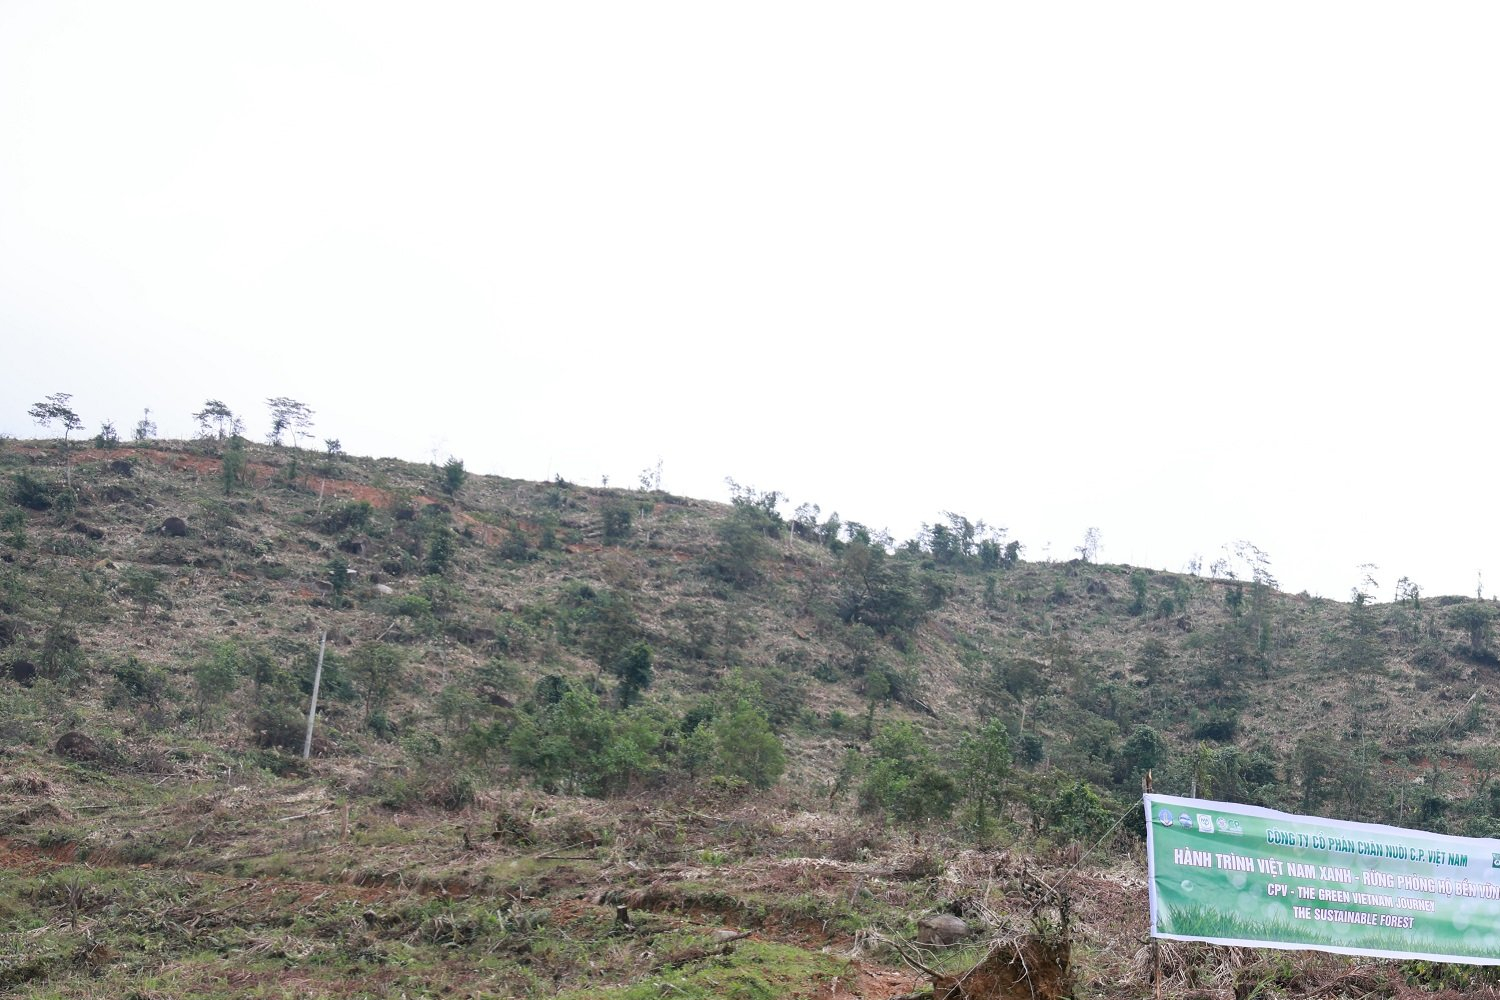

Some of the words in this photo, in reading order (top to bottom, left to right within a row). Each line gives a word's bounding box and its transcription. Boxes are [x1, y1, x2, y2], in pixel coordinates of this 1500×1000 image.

[1266, 827, 1296, 846] CÔNG
[1298, 833, 1310, 848] TY
[1385, 843, 1408, 860] NUÔI
[1410, 847, 1425, 862] C.P.
[1428, 849, 1446, 867] VIỆT
[1447, 853, 1468, 868] NAM
[1174, 847, 1212, 868] HÀNH
[1216, 852, 1254, 873] TRÌNH
[1257, 857, 1283, 878] VIỆT
[1287, 862, 1316, 880] NAM
[1319, 866, 1352, 883] XANH
[1362, 868, 1395, 888] RỪNG
[1397, 873, 1436, 894] PHÒNG
[1438, 879, 1453, 898] HỘ
[1267, 883, 1288, 897] CPV
[1297, 886, 1316, 900] THE
[1318, 889, 1350, 903] GREEN
[1352, 892, 1394, 908] VIETNAM
[1396, 896, 1436, 912] JOURNEY
[1293, 906, 1311, 920] THE
[1314, 908, 1378, 925] SUSTAINABLE
[1380, 914, 1415, 929] FOREST
